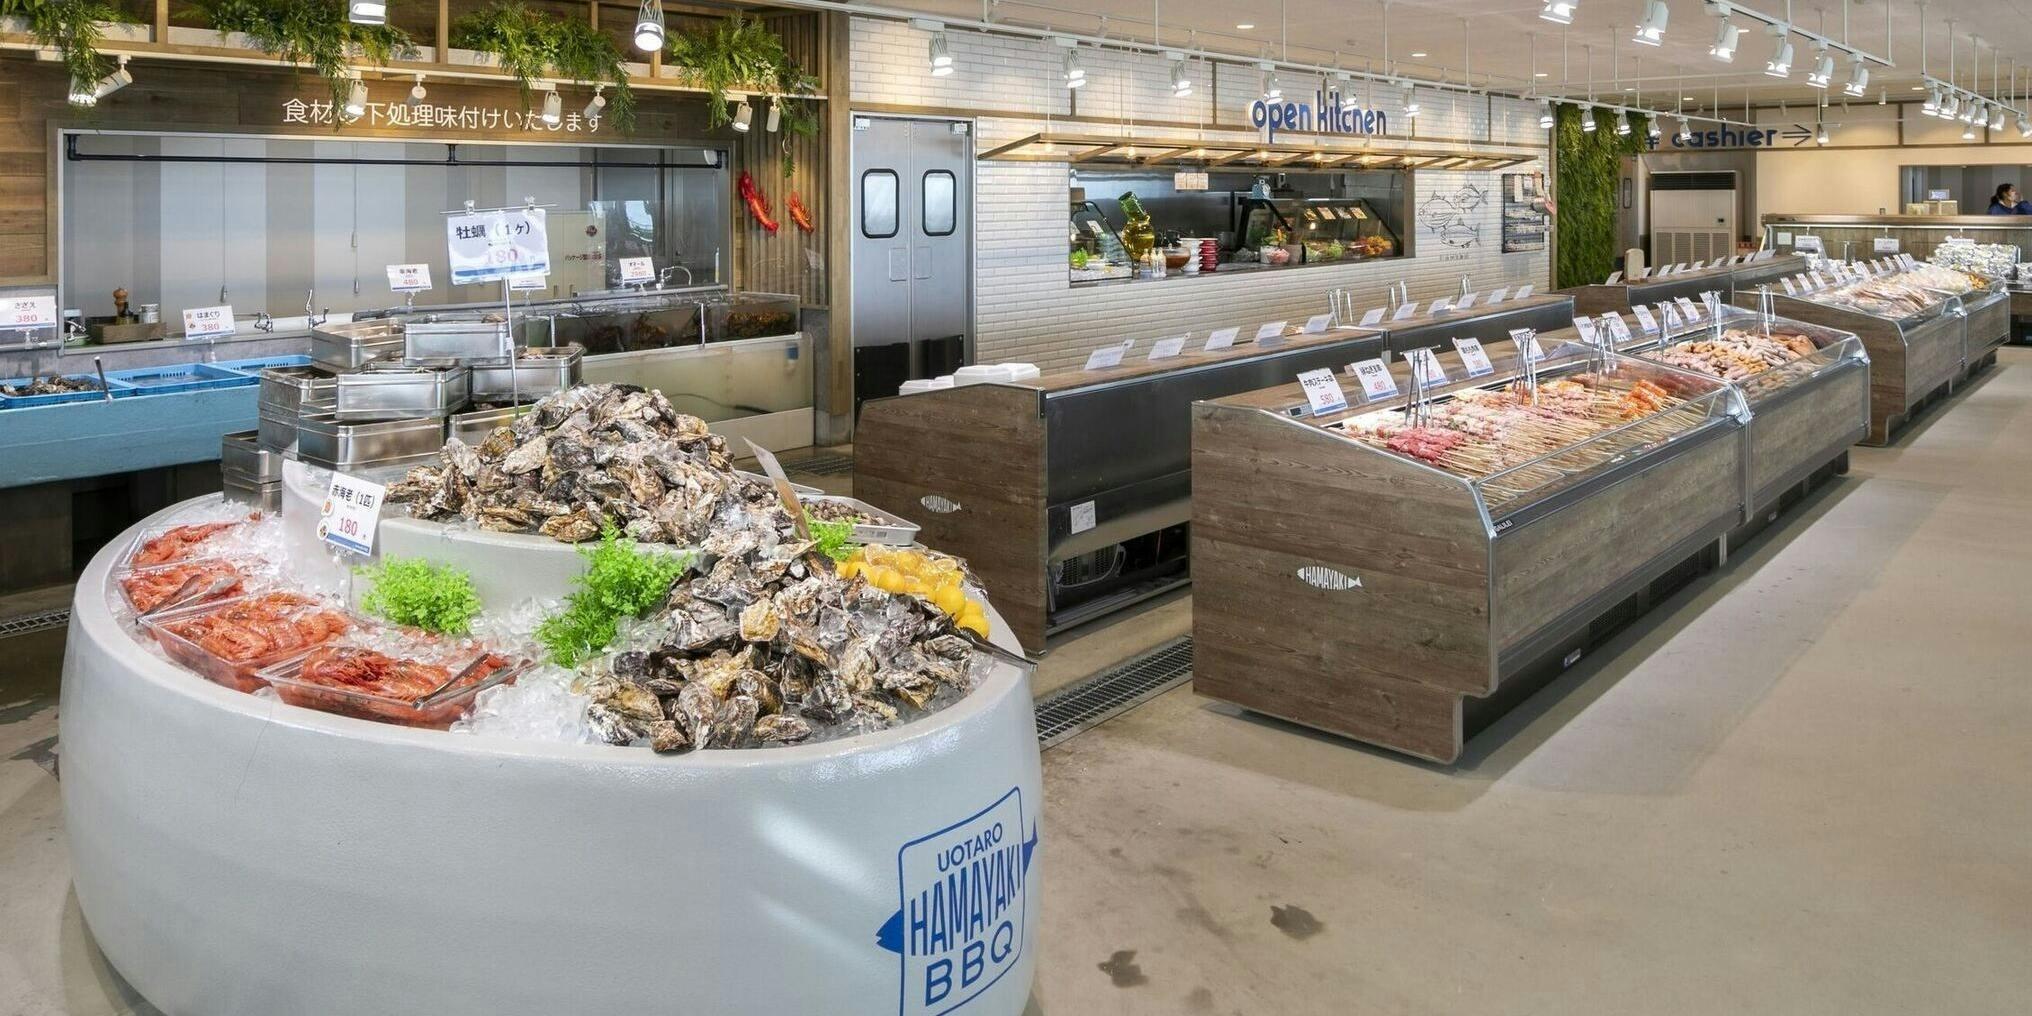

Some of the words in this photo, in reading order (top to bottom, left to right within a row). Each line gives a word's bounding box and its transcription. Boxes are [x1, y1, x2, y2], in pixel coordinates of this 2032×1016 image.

[1252, 100, 1312, 144] open
[1317, 89, 1387, 136] kitchen
[1671, 121, 1778, 148] cashier
[15, 314, 38, 323] 380
[338, 517, 359, 537] 180
[1305, 566, 1347, 591] HAMAYAKI
[936, 822, 1004, 873] UOTARO
[910, 843, 1021, 957] HAMAYAKI
[924, 919, 1016, 1007] BBQ
